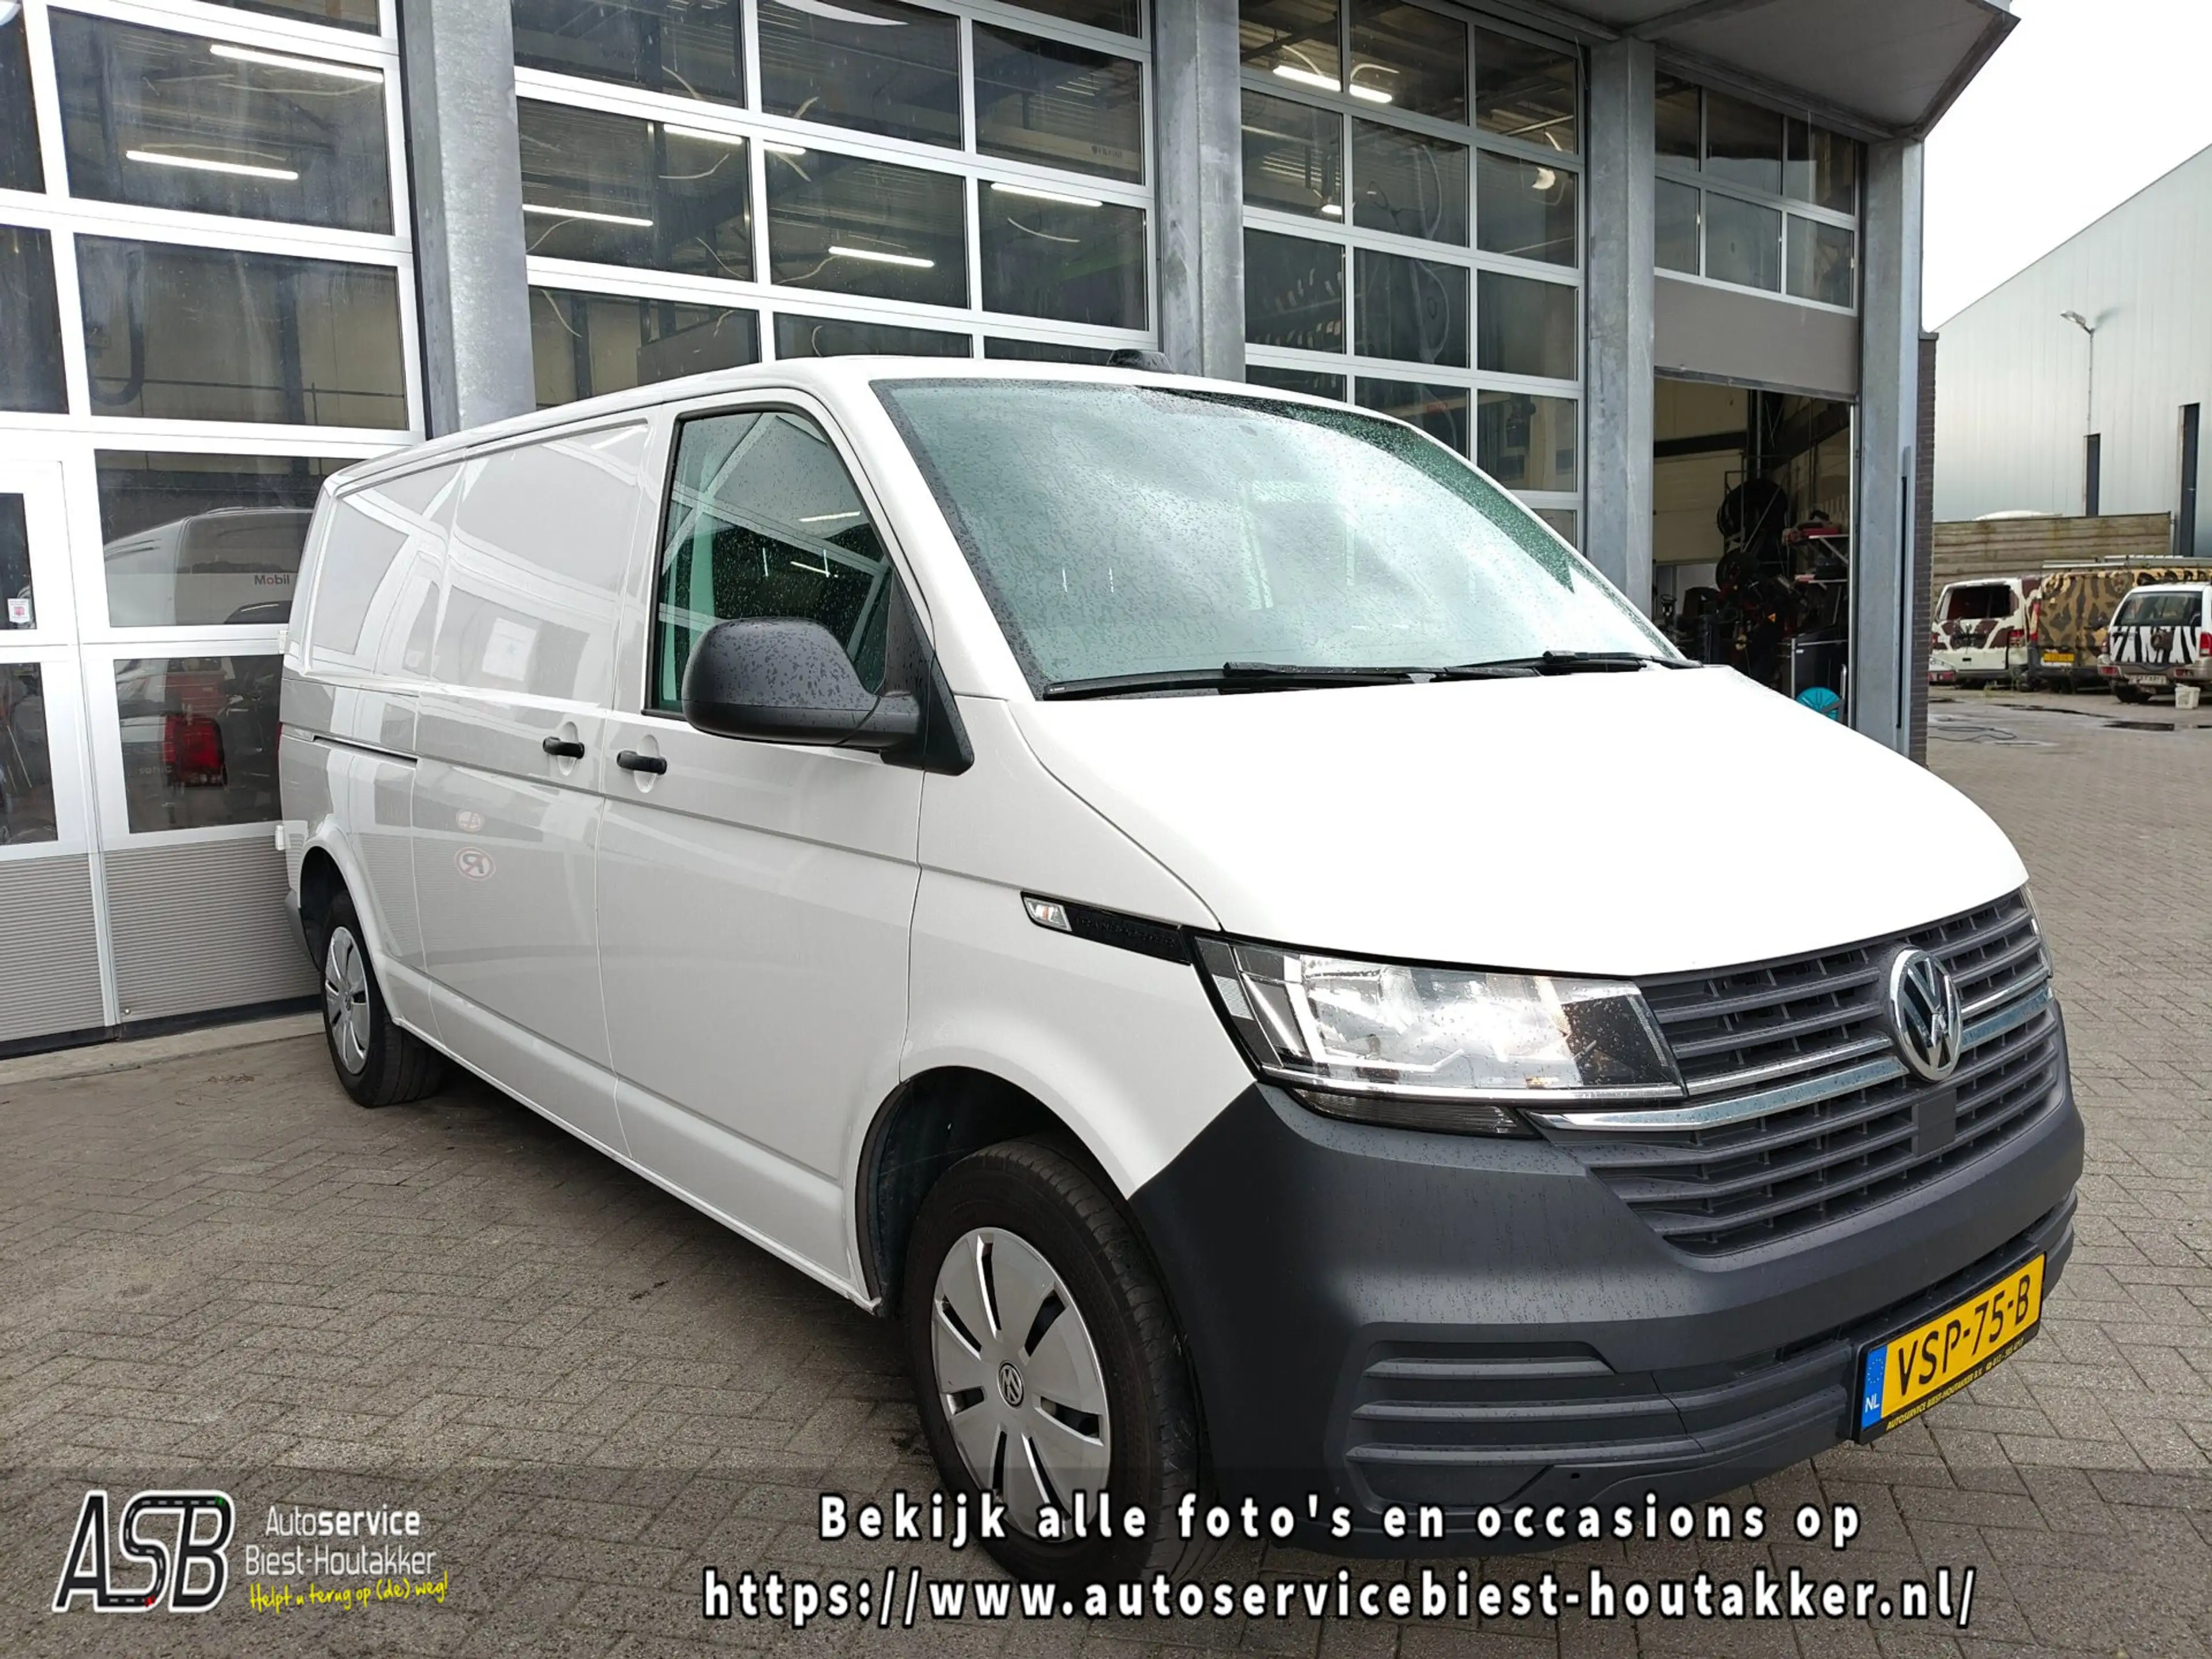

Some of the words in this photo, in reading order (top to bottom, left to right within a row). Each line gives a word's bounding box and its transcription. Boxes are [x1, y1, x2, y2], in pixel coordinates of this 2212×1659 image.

[253, 574, 290, 585] Mobil
[1898, 1274, 2031, 1397] VSP-75-B
[1865, 1393, 1880, 1413] NL
